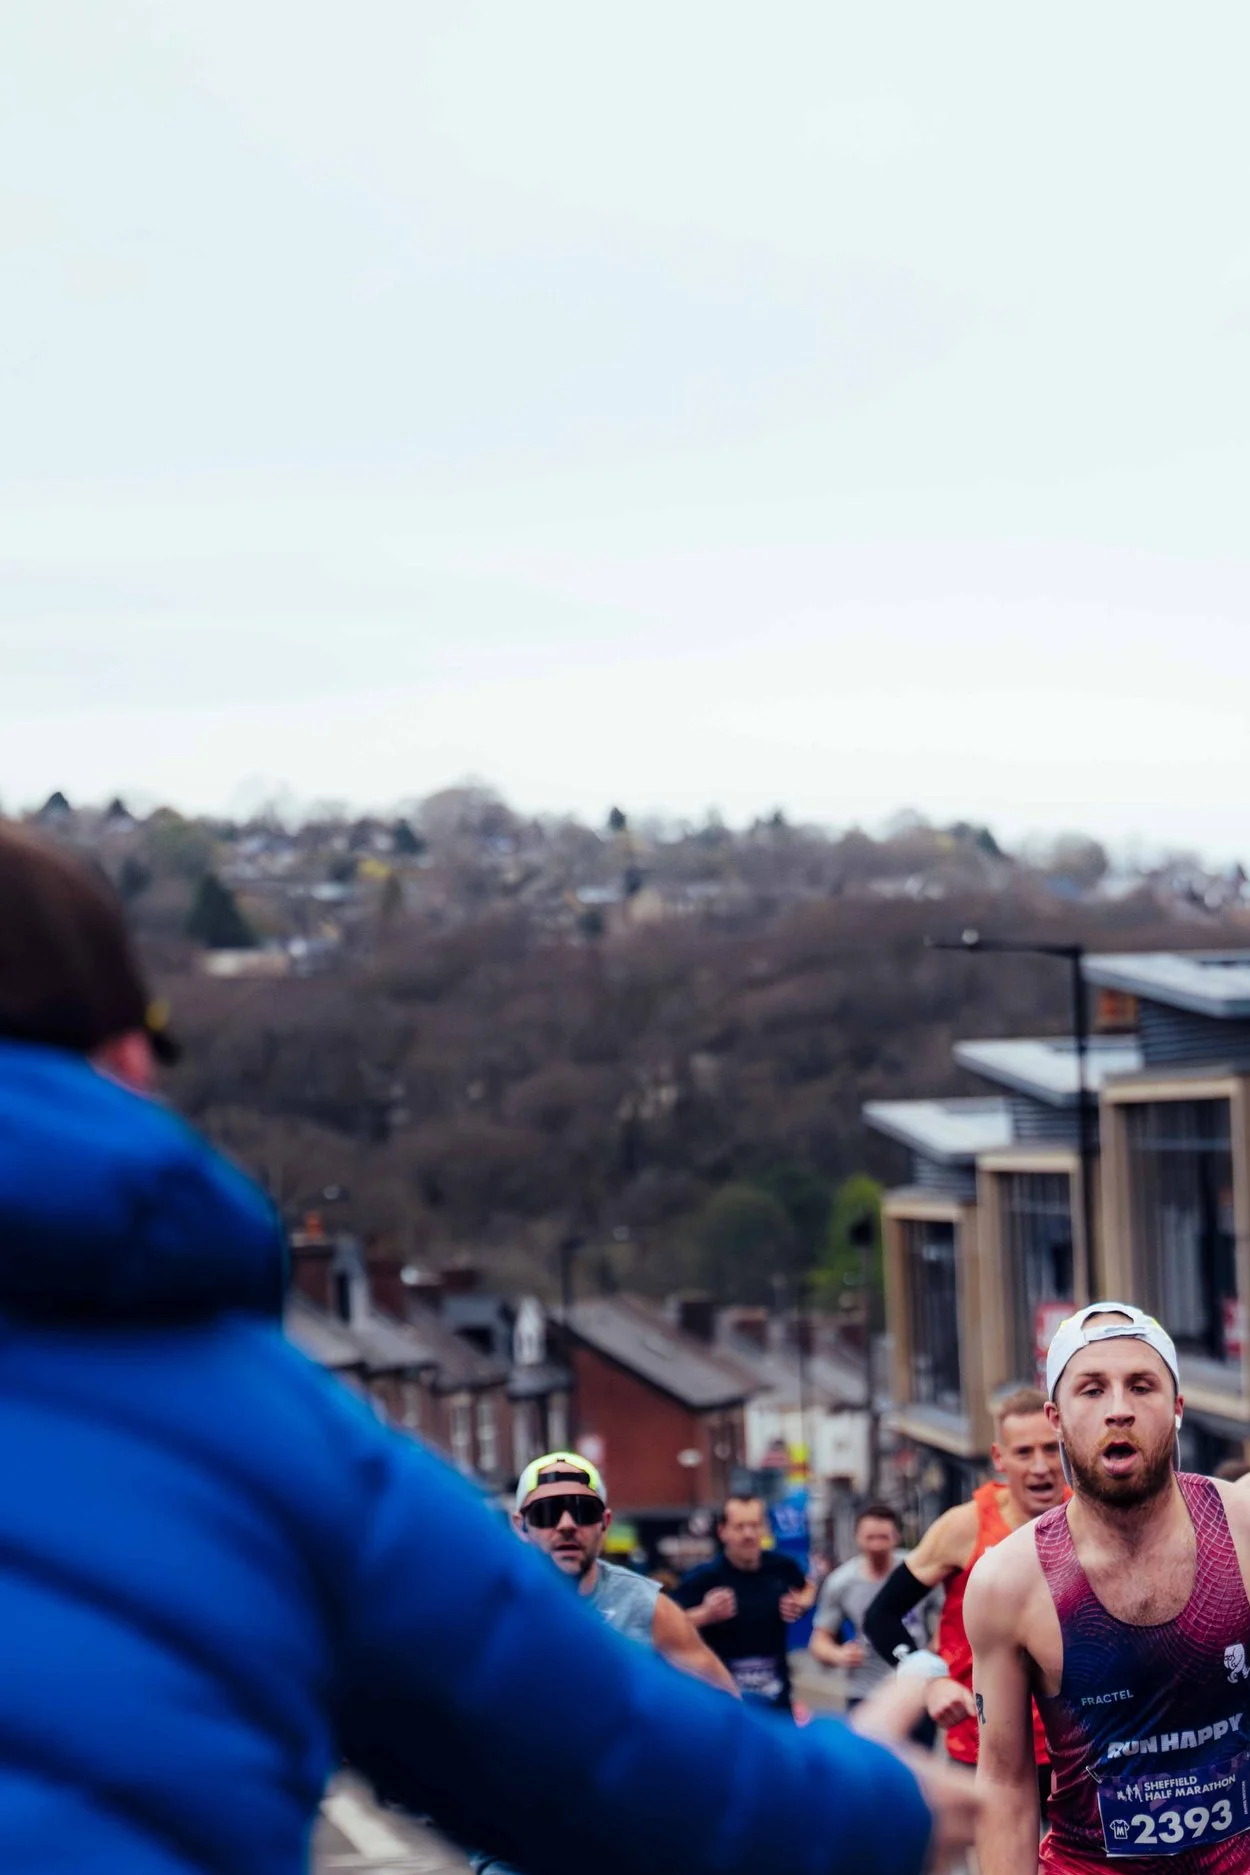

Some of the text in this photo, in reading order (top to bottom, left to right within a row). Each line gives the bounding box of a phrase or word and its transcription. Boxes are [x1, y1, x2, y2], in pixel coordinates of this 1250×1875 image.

[1081, 1689, 1134, 1706] FRACTEL
[1107, 1712, 1243, 1759] RUN HAPPY
[1144, 1775, 1198, 1792] SHEFFIELD
[1144, 1789, 1172, 1802] HALF
[1175, 1774, 1236, 1798] MARATHON
[1131, 1799, 1233, 1844] 2393
